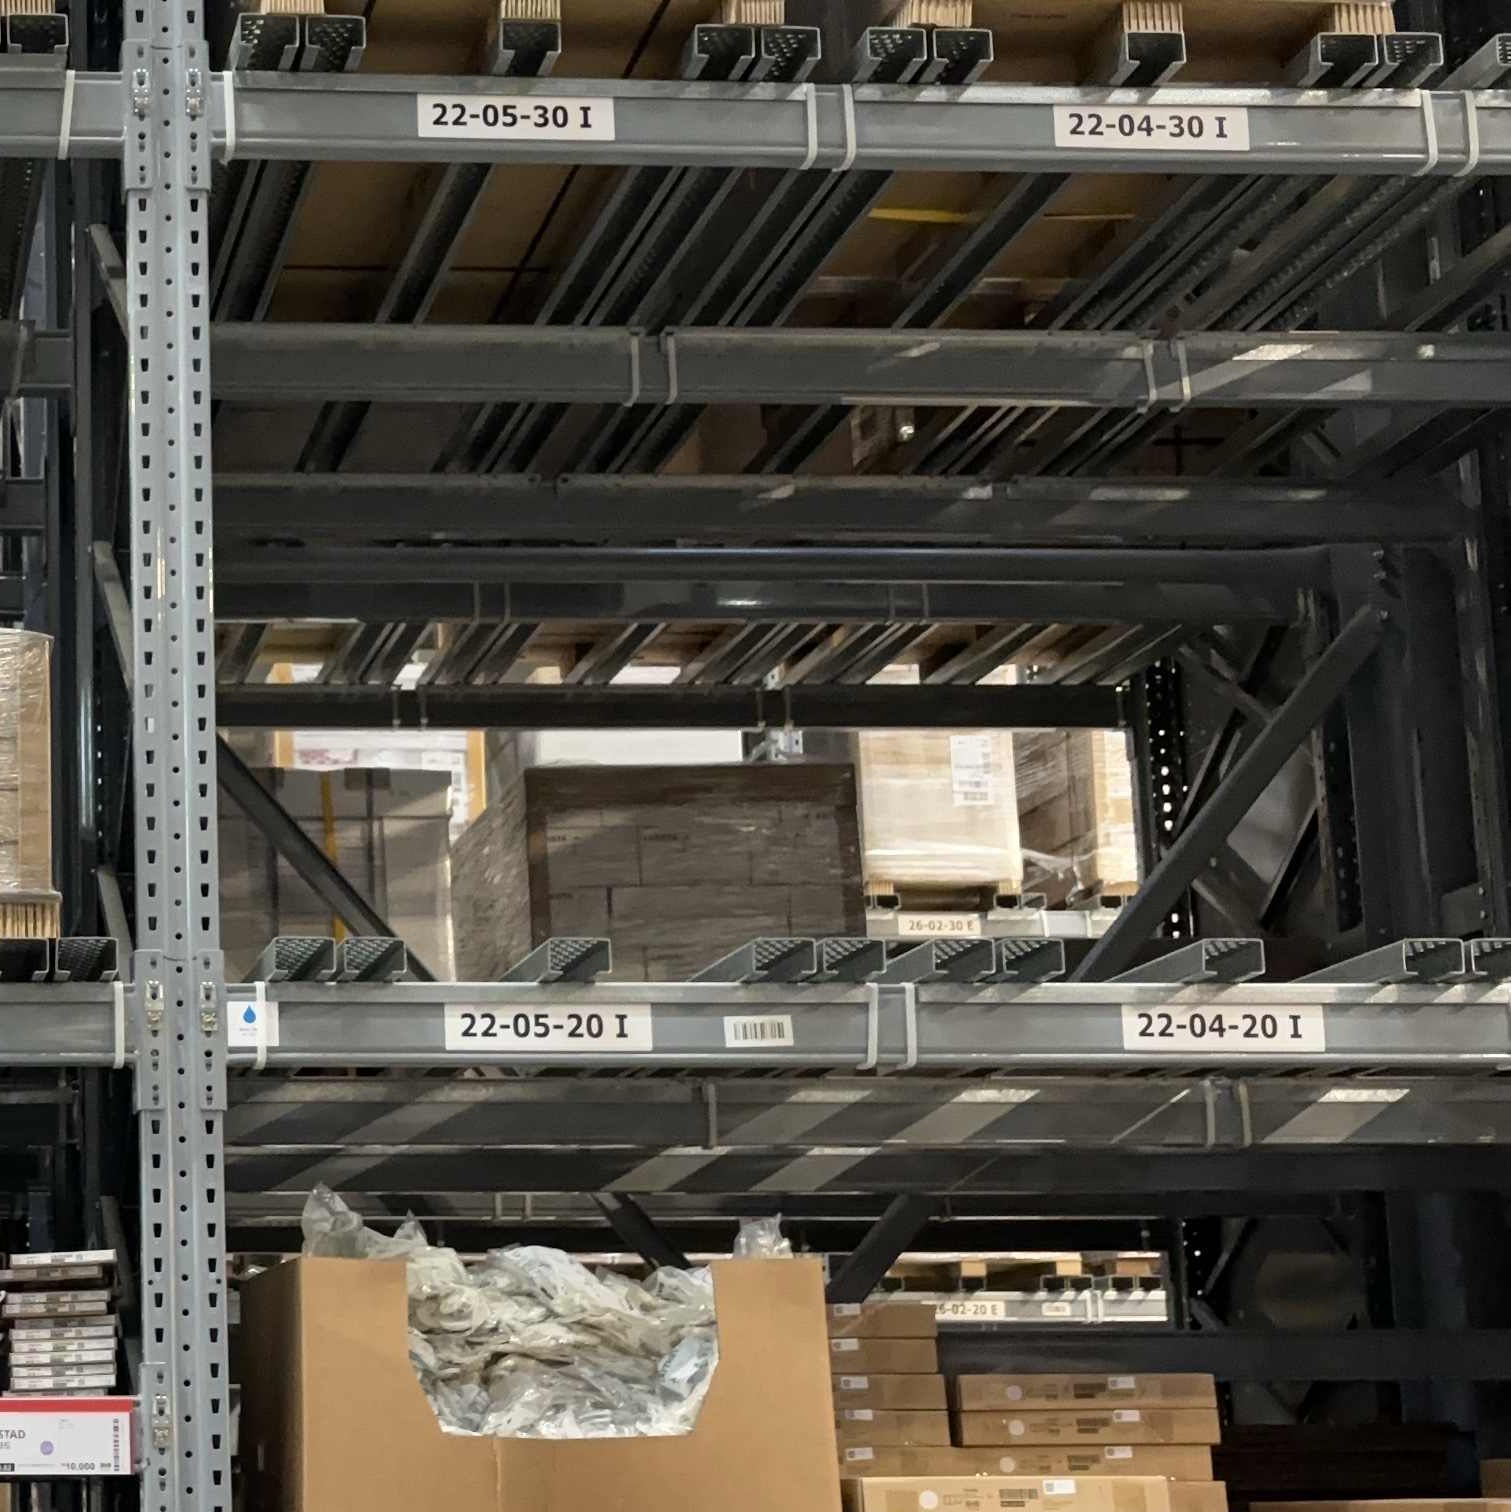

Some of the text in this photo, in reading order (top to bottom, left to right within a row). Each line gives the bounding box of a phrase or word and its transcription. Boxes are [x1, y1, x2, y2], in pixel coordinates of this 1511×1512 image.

[431, 103, 592, 130] 22-05-30 I
[1068, 113, 1228, 139] 22-04-30 I
[908, 920, 962, 931] 26-02-30
[460, 1014, 628, 1039] 22-05-20 I
[1138, 1013, 1303, 1039] 22-04-20 I
